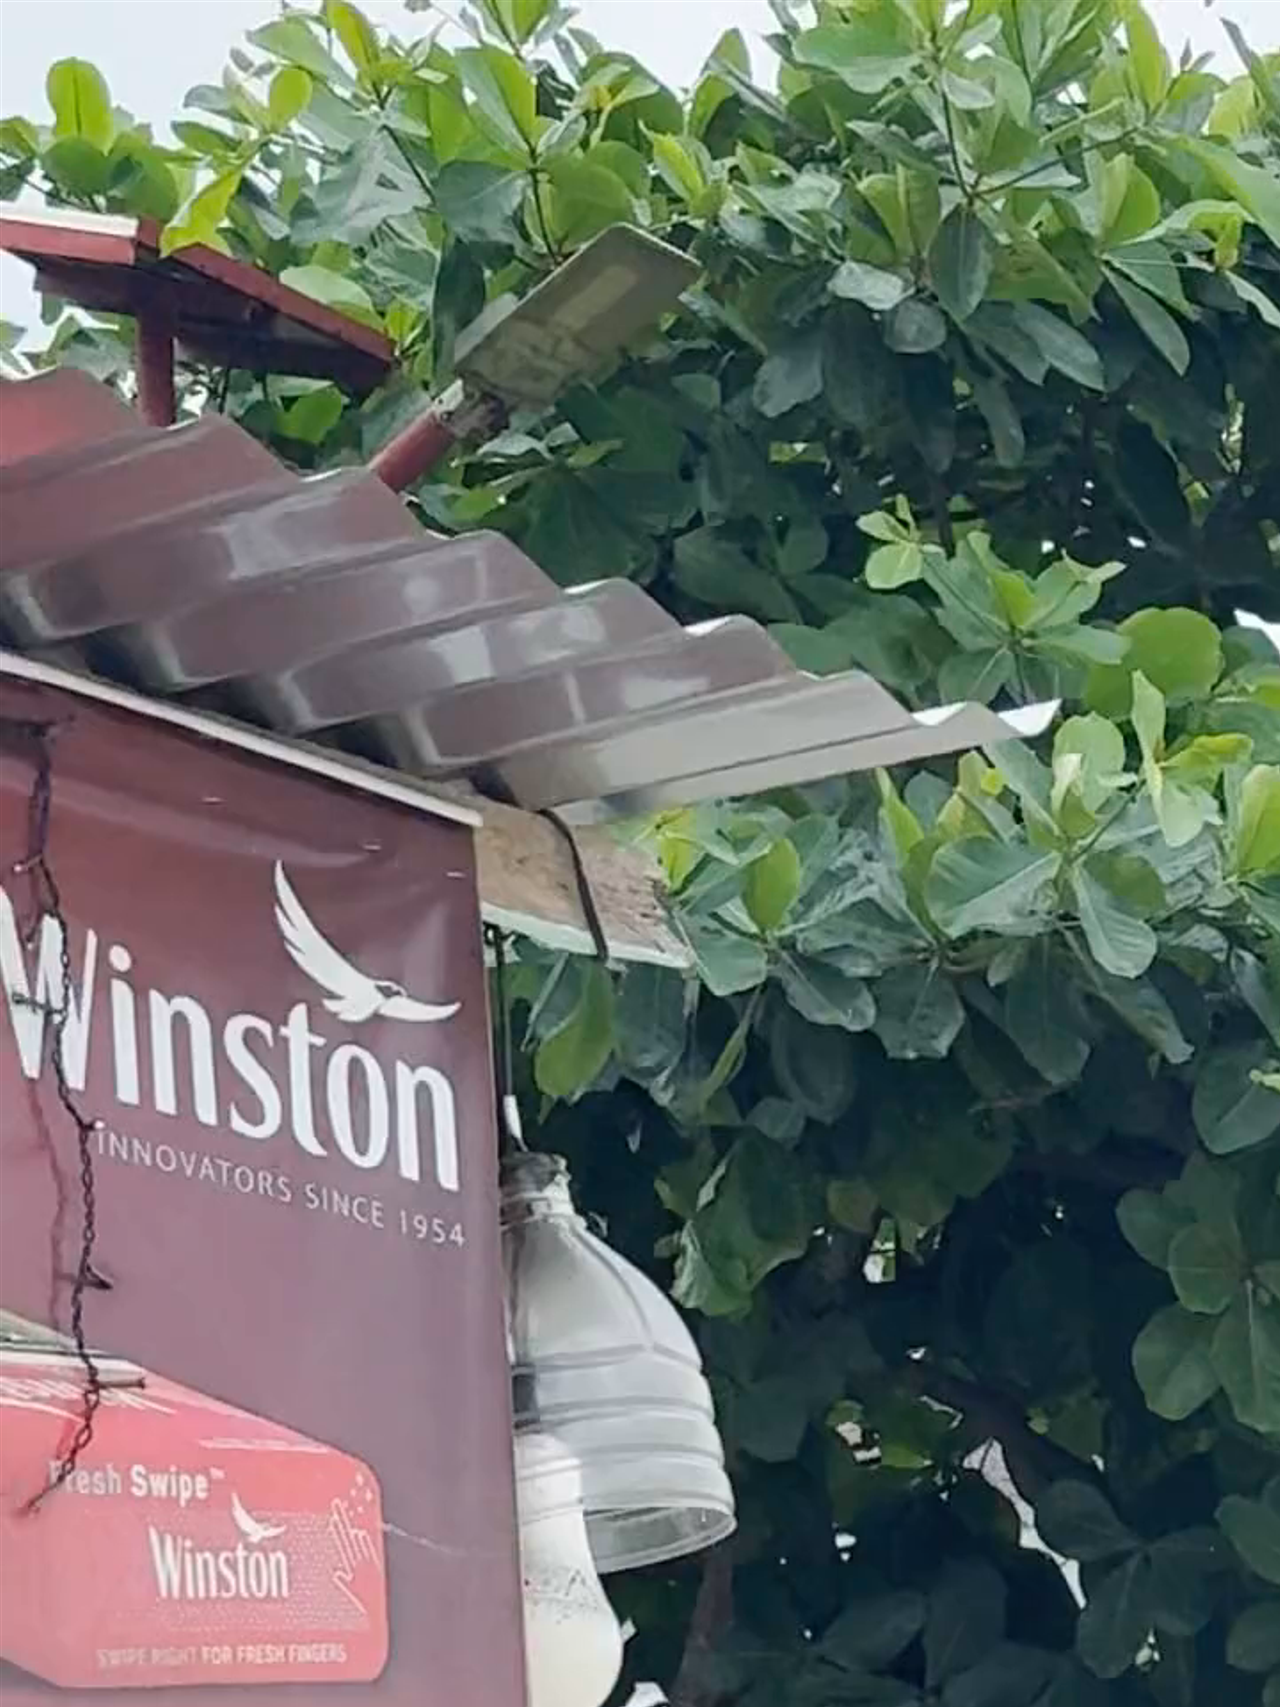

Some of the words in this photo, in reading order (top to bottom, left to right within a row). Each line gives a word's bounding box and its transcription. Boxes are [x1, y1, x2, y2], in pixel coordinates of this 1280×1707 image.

[0, 884, 459, 1192] Winston
[96, 1131, 293, 1203] INNOVATORS
[305, 1182, 385, 1228] SINCE
[401, 1210, 465, 1248] 1954
[49, 1460, 121, 1494] Fresh
[148, 1524, 289, 1599] Winston
[201, 1645, 233, 1665] FOR
[237, 1644, 286, 1665] FRESH
